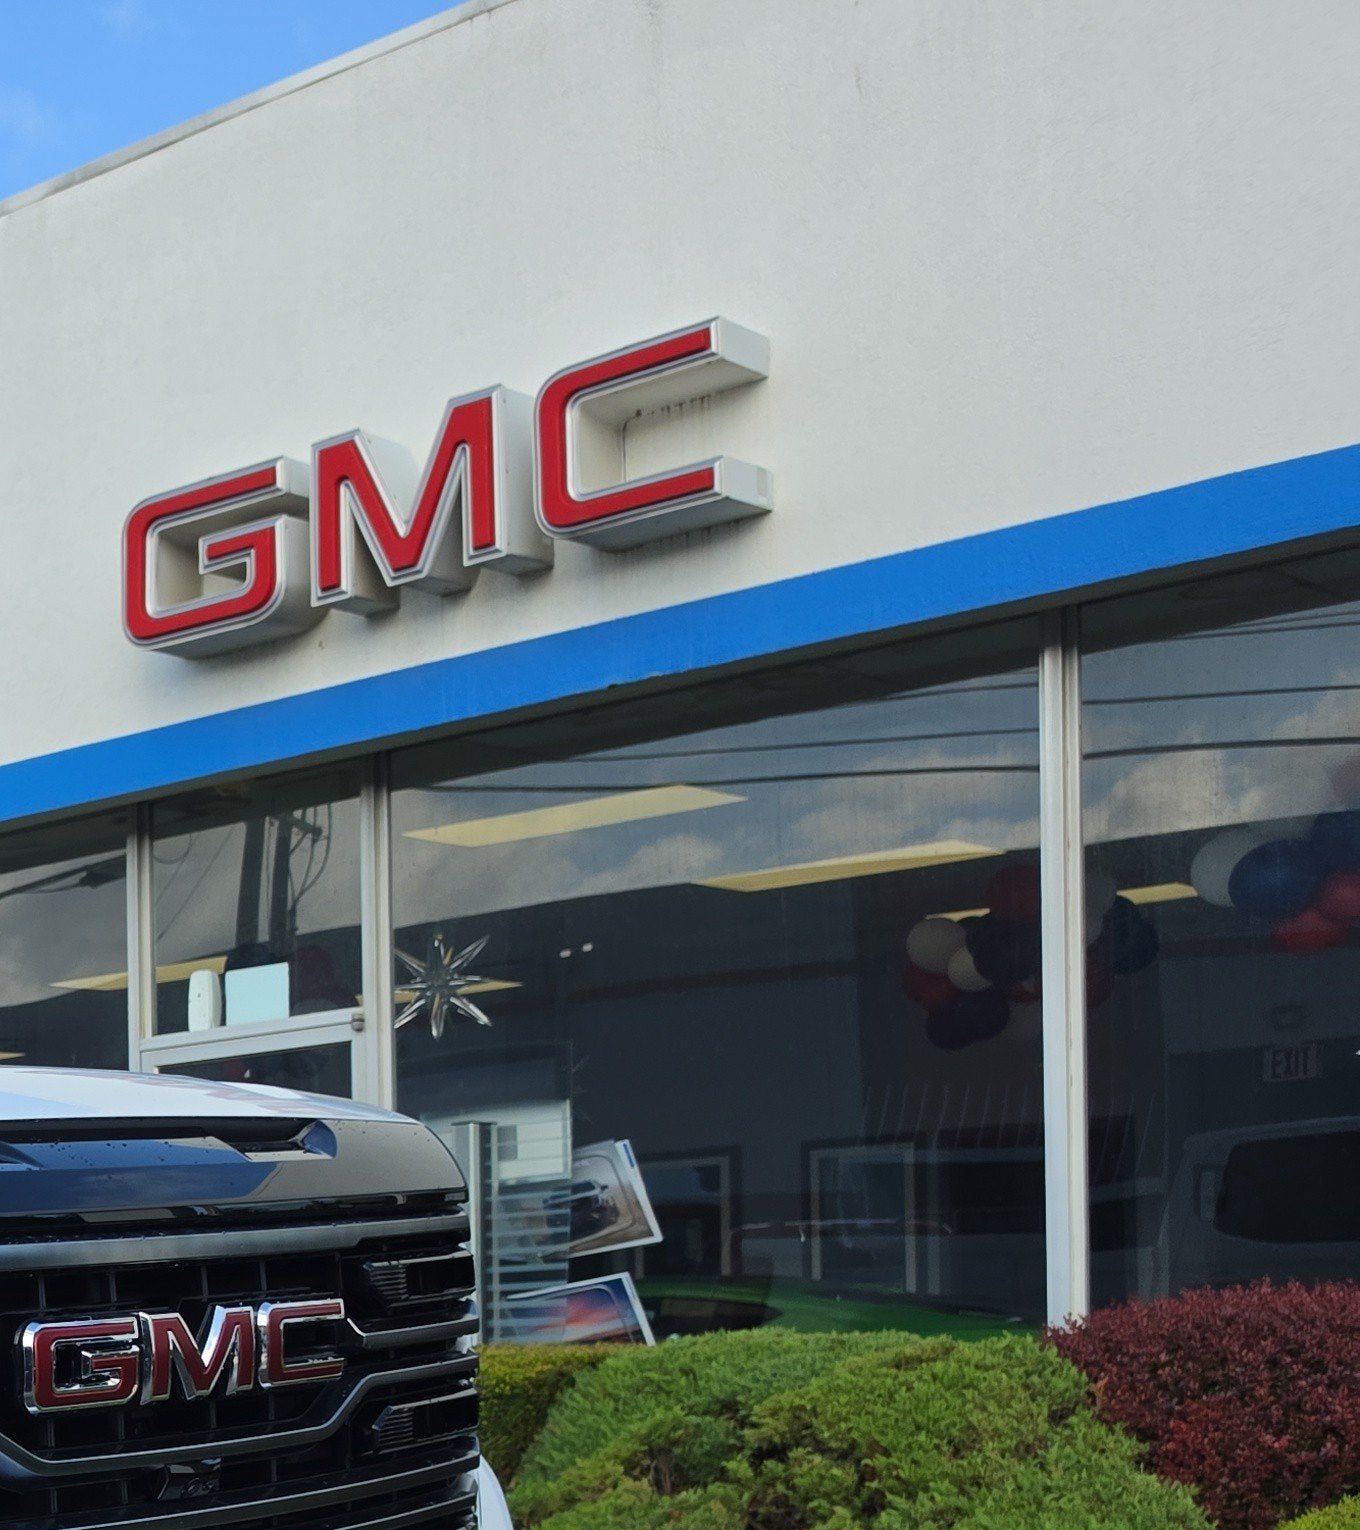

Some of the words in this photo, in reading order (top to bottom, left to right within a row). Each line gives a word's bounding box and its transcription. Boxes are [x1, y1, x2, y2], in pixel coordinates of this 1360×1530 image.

[121, 317, 732, 655] GMC
[1271, 1045, 1314, 1079] EXIT
[22, 1297, 346, 1414] GMC
